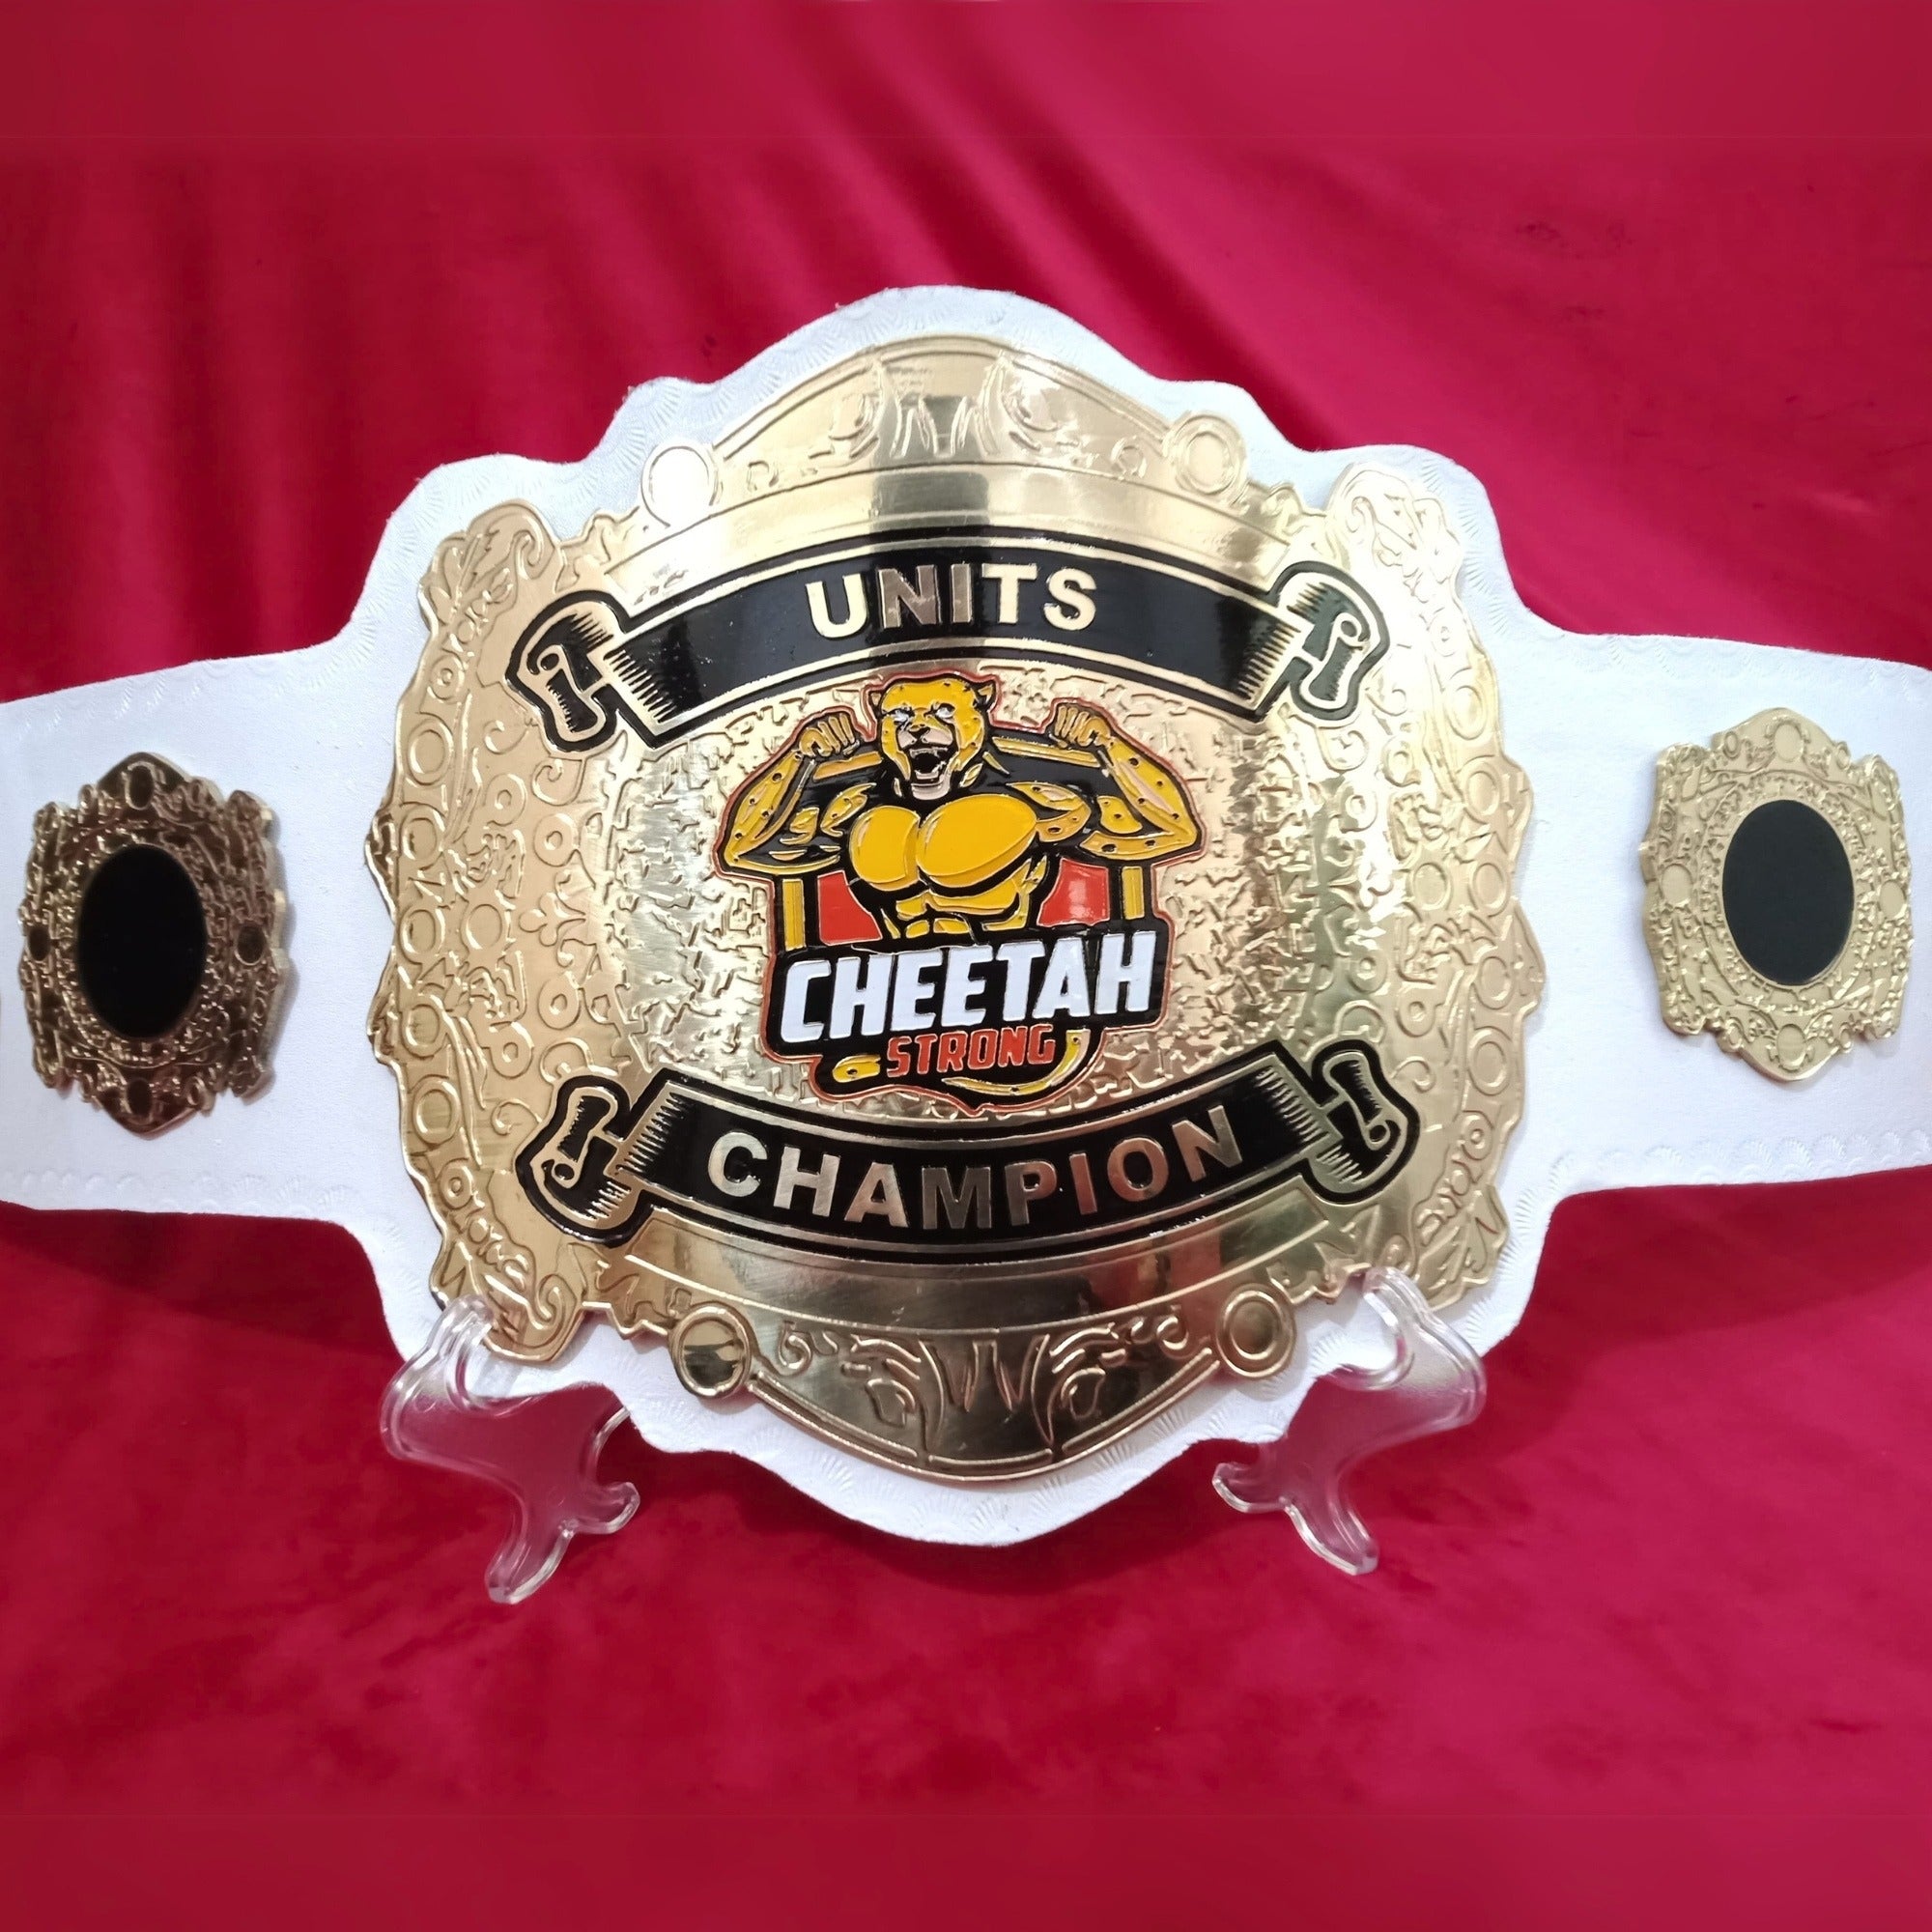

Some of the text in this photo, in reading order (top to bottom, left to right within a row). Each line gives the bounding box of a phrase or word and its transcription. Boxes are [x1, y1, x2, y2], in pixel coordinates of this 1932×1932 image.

[807, 563, 1096, 639] UNITS
[780, 930, 1157, 1043] CHEETAH
[886, 1024, 1056, 1078] STRONG
[708, 1105, 1243, 1230] CHAMPION
